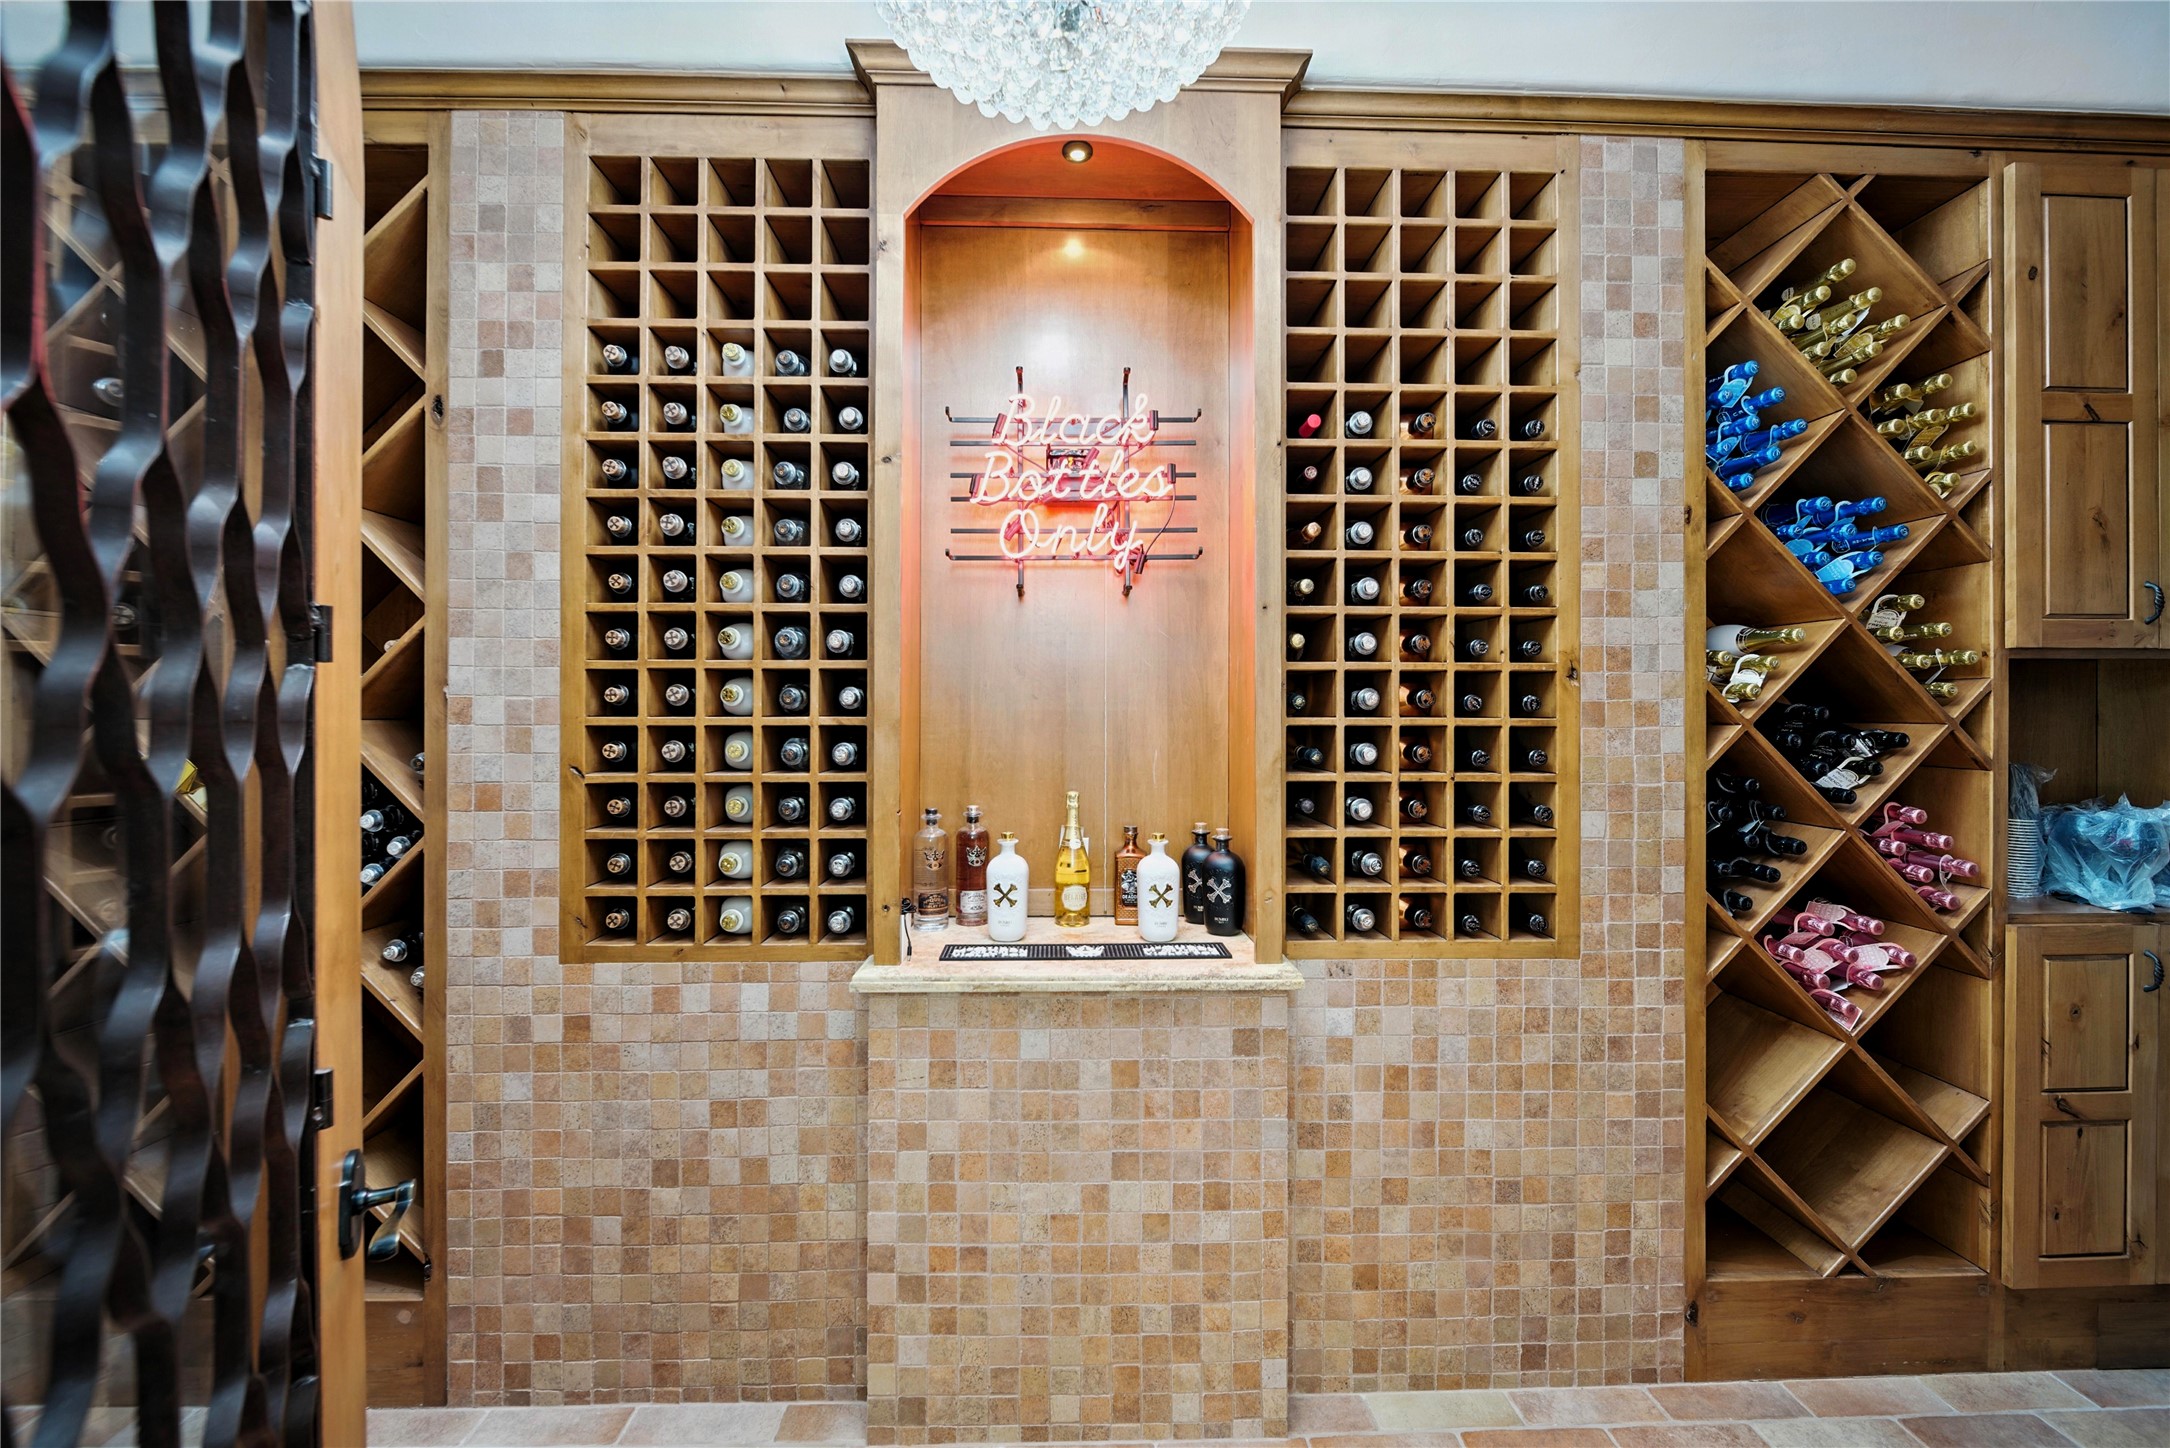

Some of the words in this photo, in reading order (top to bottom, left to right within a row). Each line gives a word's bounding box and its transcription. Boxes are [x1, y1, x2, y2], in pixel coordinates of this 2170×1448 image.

[992, 393, 1155, 447] Black
[969, 448, 1176, 504] Bottles
[999, 503, 1143, 570] Only
